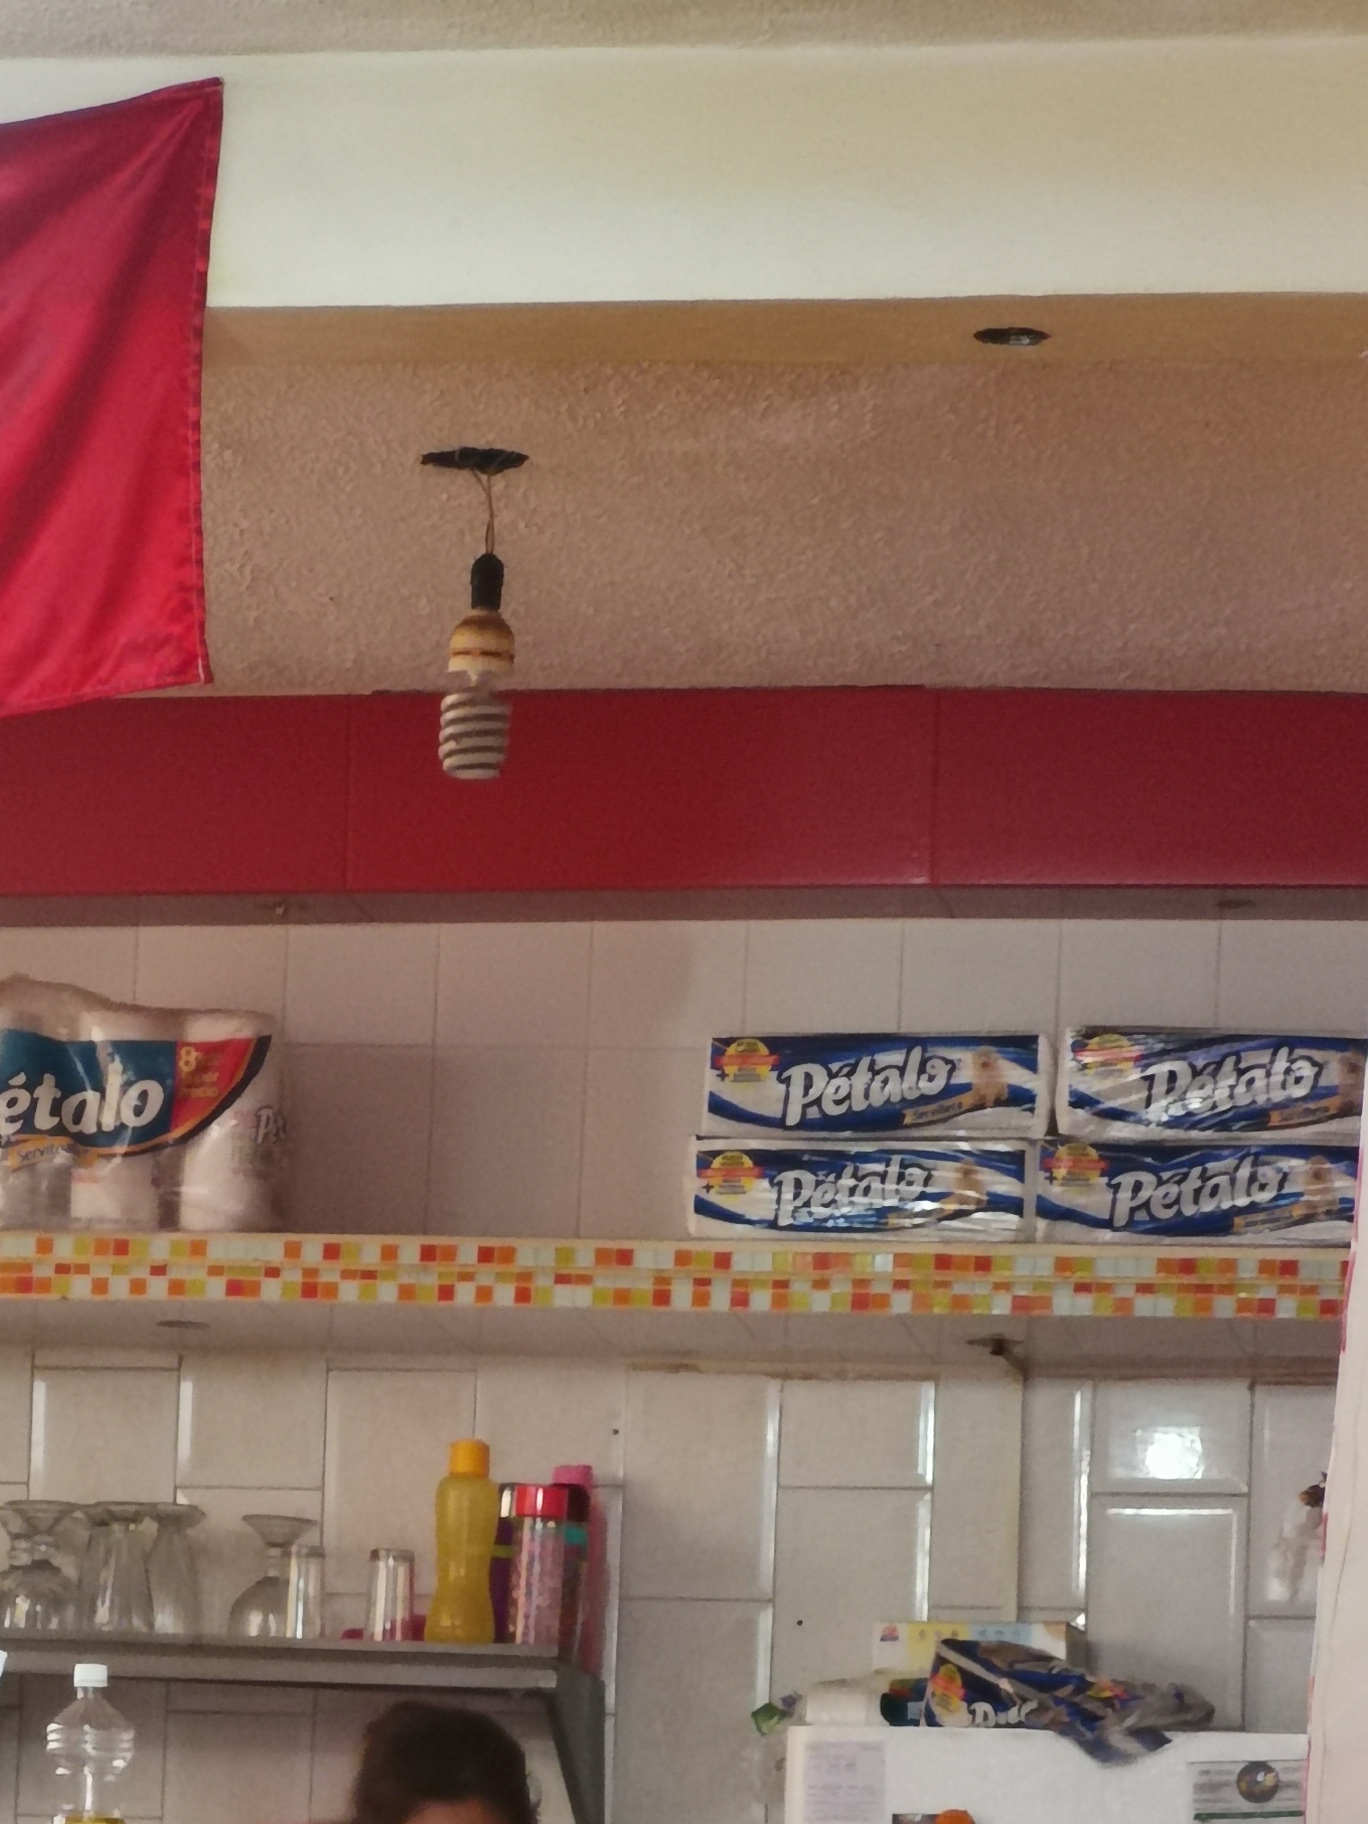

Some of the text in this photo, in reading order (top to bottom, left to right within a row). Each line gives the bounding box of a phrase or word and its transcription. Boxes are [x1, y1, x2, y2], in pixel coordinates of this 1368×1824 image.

[782, 1046, 951, 1127] Pétalo
[1140, 1046, 1319, 1124] Pétalo
[774, 1155, 927, 1227] Pétalo
[1111, 1156, 1284, 1228] Pétalo
